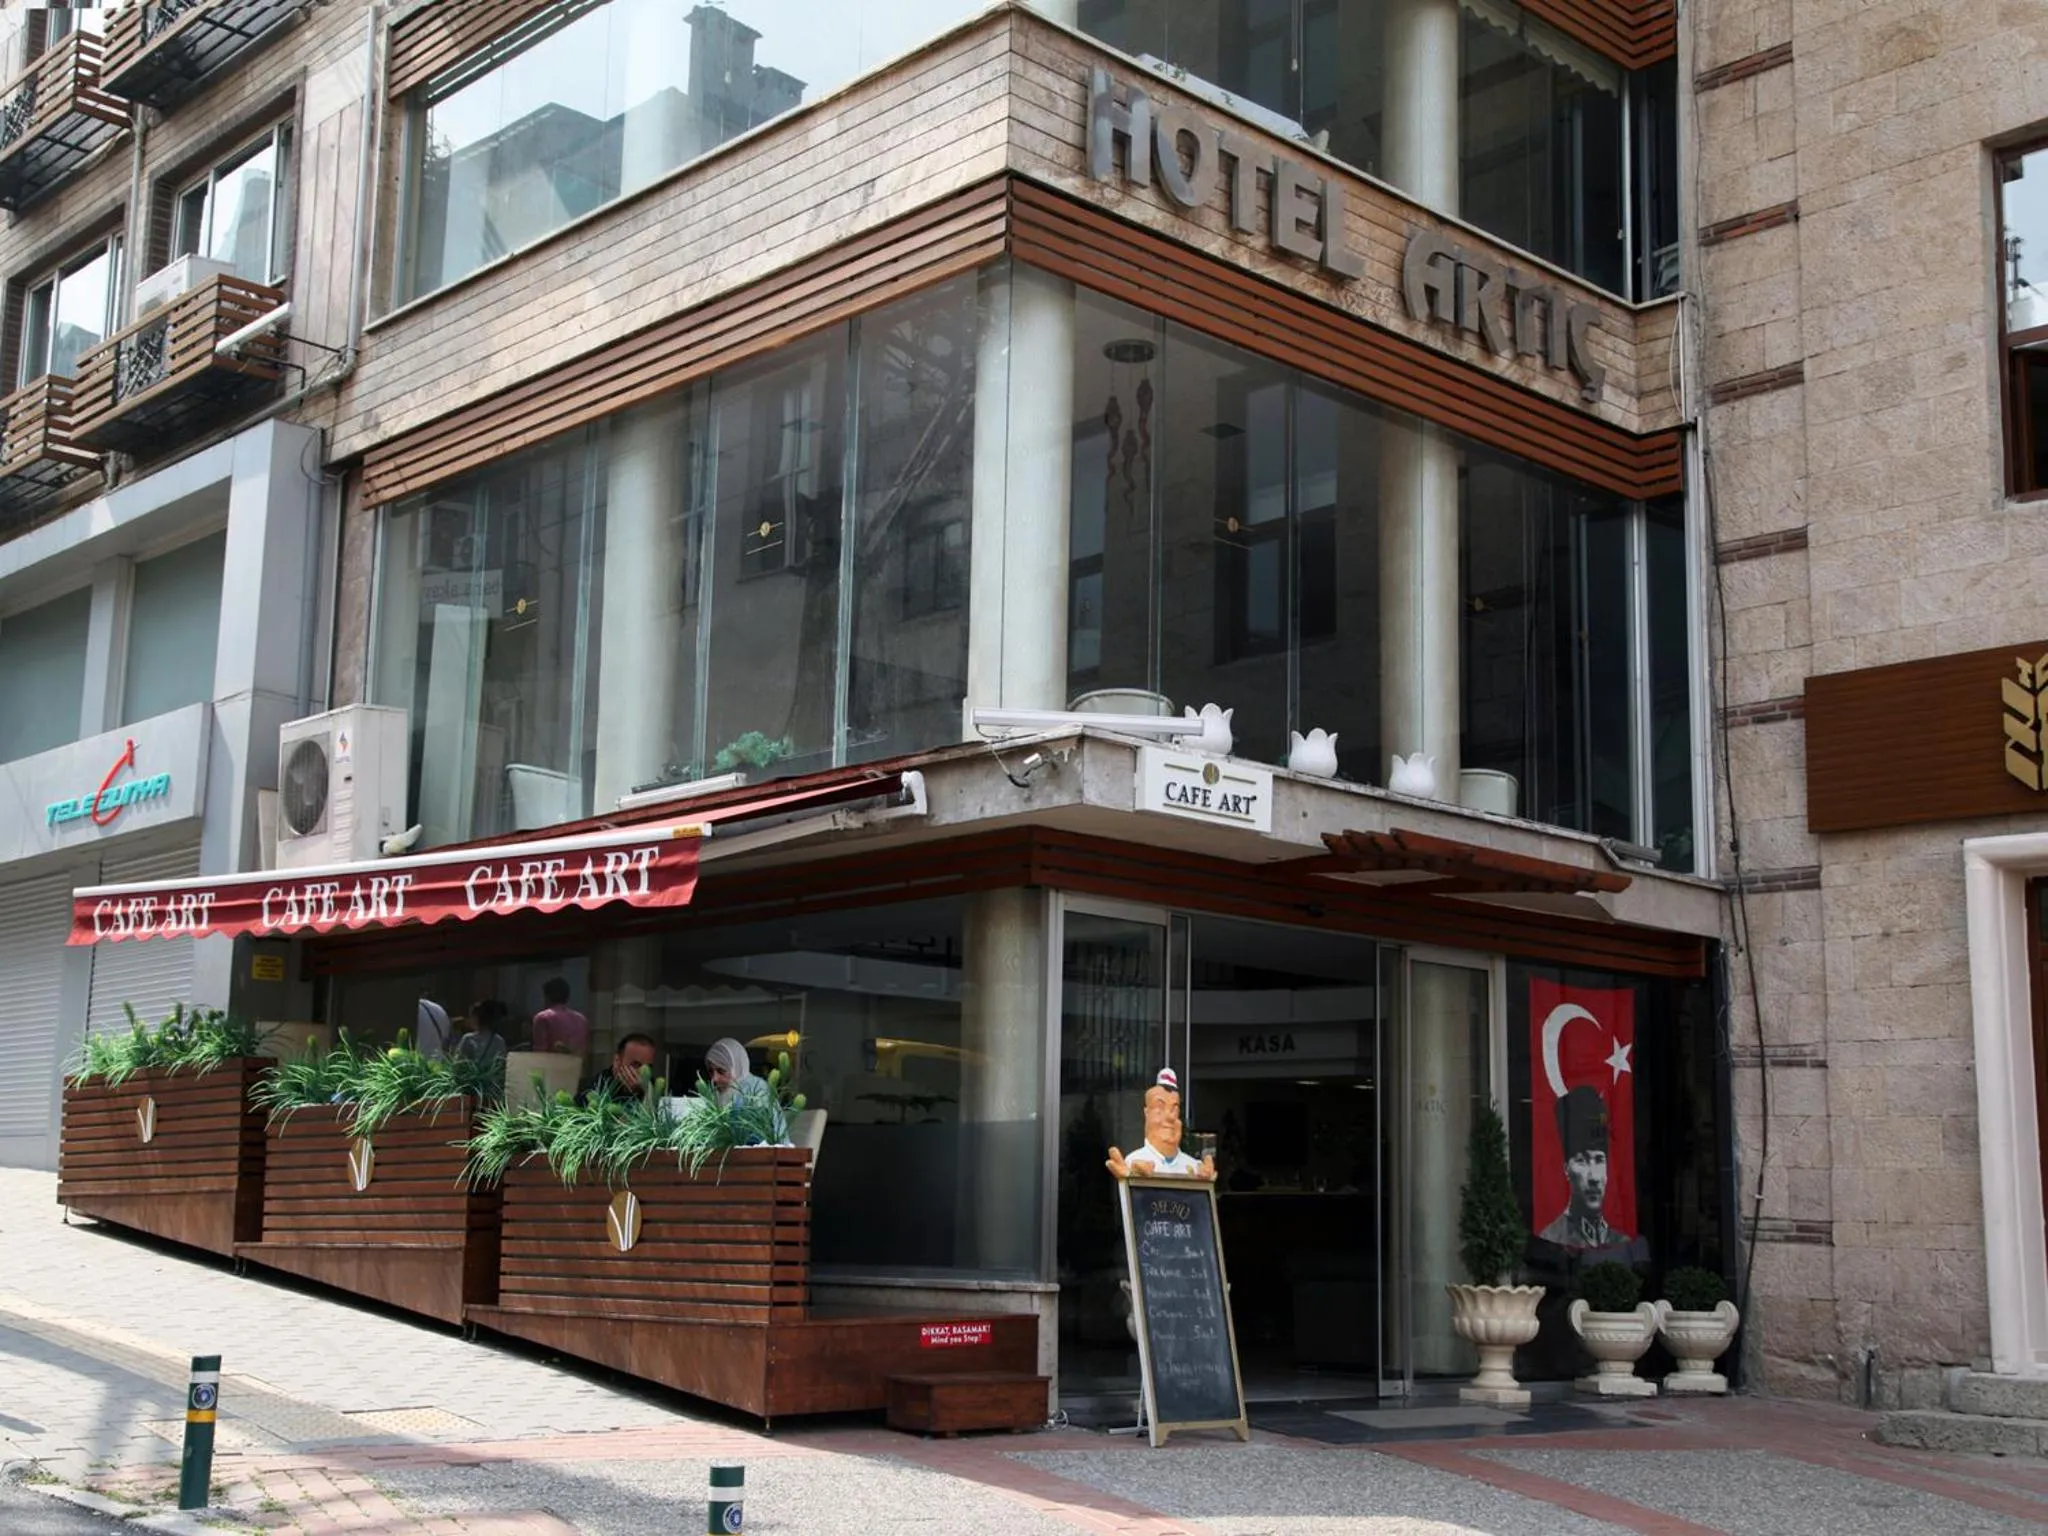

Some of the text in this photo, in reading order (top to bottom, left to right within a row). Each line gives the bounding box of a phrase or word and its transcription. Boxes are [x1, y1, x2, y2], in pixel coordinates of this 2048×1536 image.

[1086, 62, 1366, 280] HOTEL
[1165, 781, 1257, 815] CAFE ART
[262, 874, 413, 929] CAFE ART
[464, 847, 659, 911] CAFE ART
[92, 892, 216, 937] CAFE ART
[1237, 1033, 1296, 1055] KASA
[1144, 1220, 1192, 1239] CAFE ART
